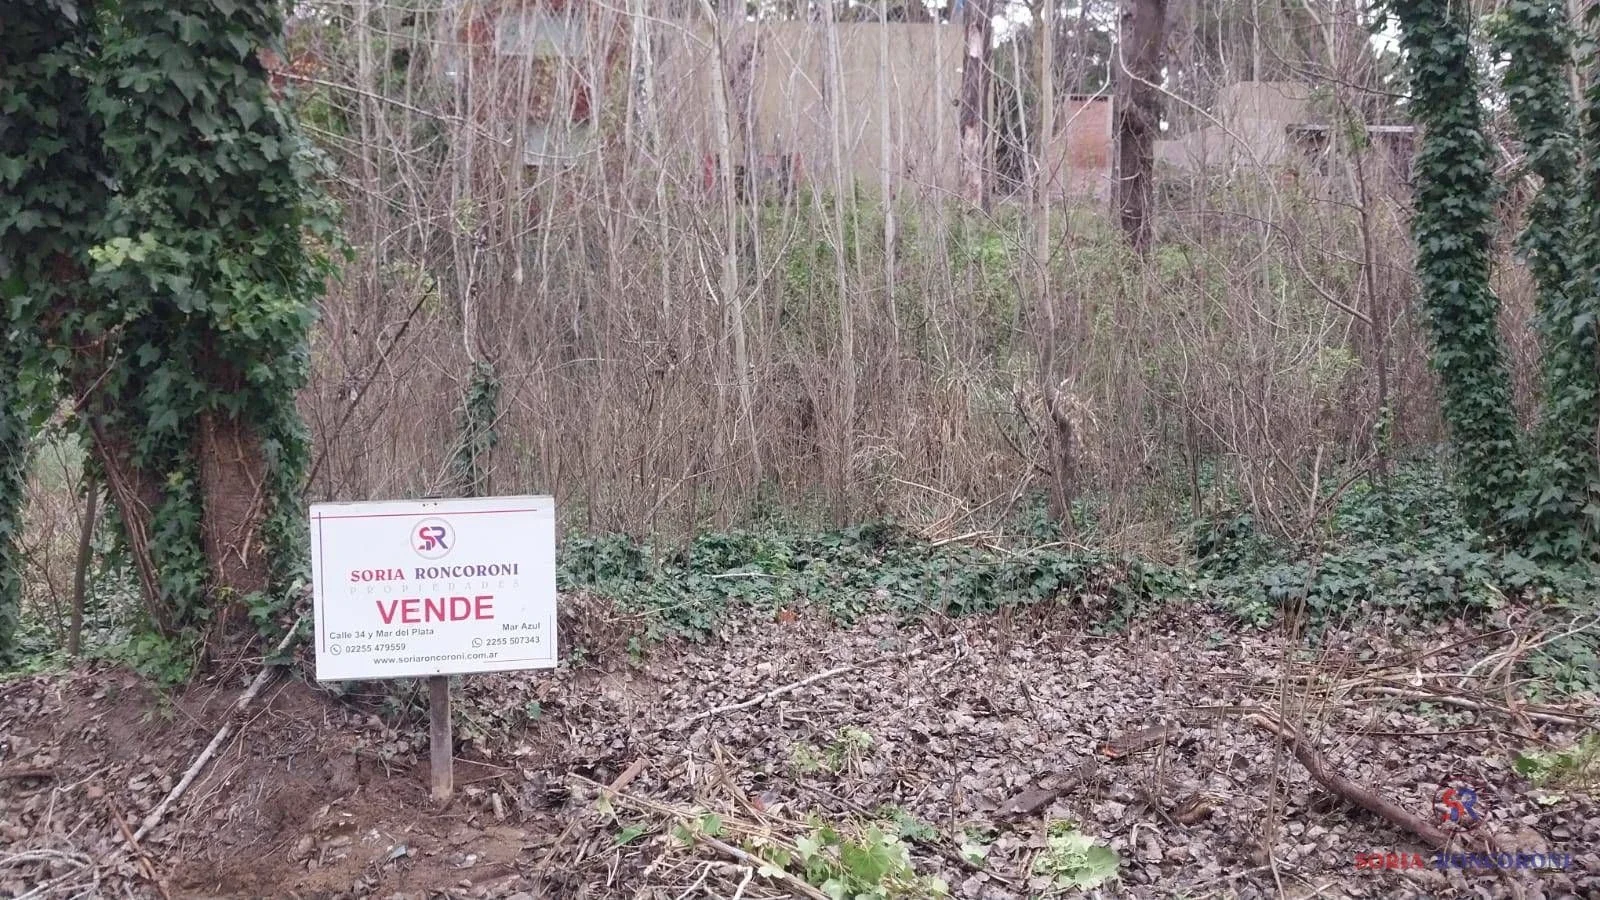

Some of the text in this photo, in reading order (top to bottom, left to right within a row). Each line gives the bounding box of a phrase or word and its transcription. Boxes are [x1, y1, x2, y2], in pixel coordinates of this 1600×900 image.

[351, 563, 519, 582] SORIA RONCORONI
[376, 595, 494, 625] VENDE
[502, 622, 541, 631] Mar Azul
[329, 627, 434, 640] Calle 34 y Mar del Plata
[486, 636, 540, 646] 2255 507343
[345, 643, 406, 653] 02255 479559
[373, 651, 498, 665] www.soriaroncoroni.com.ar
